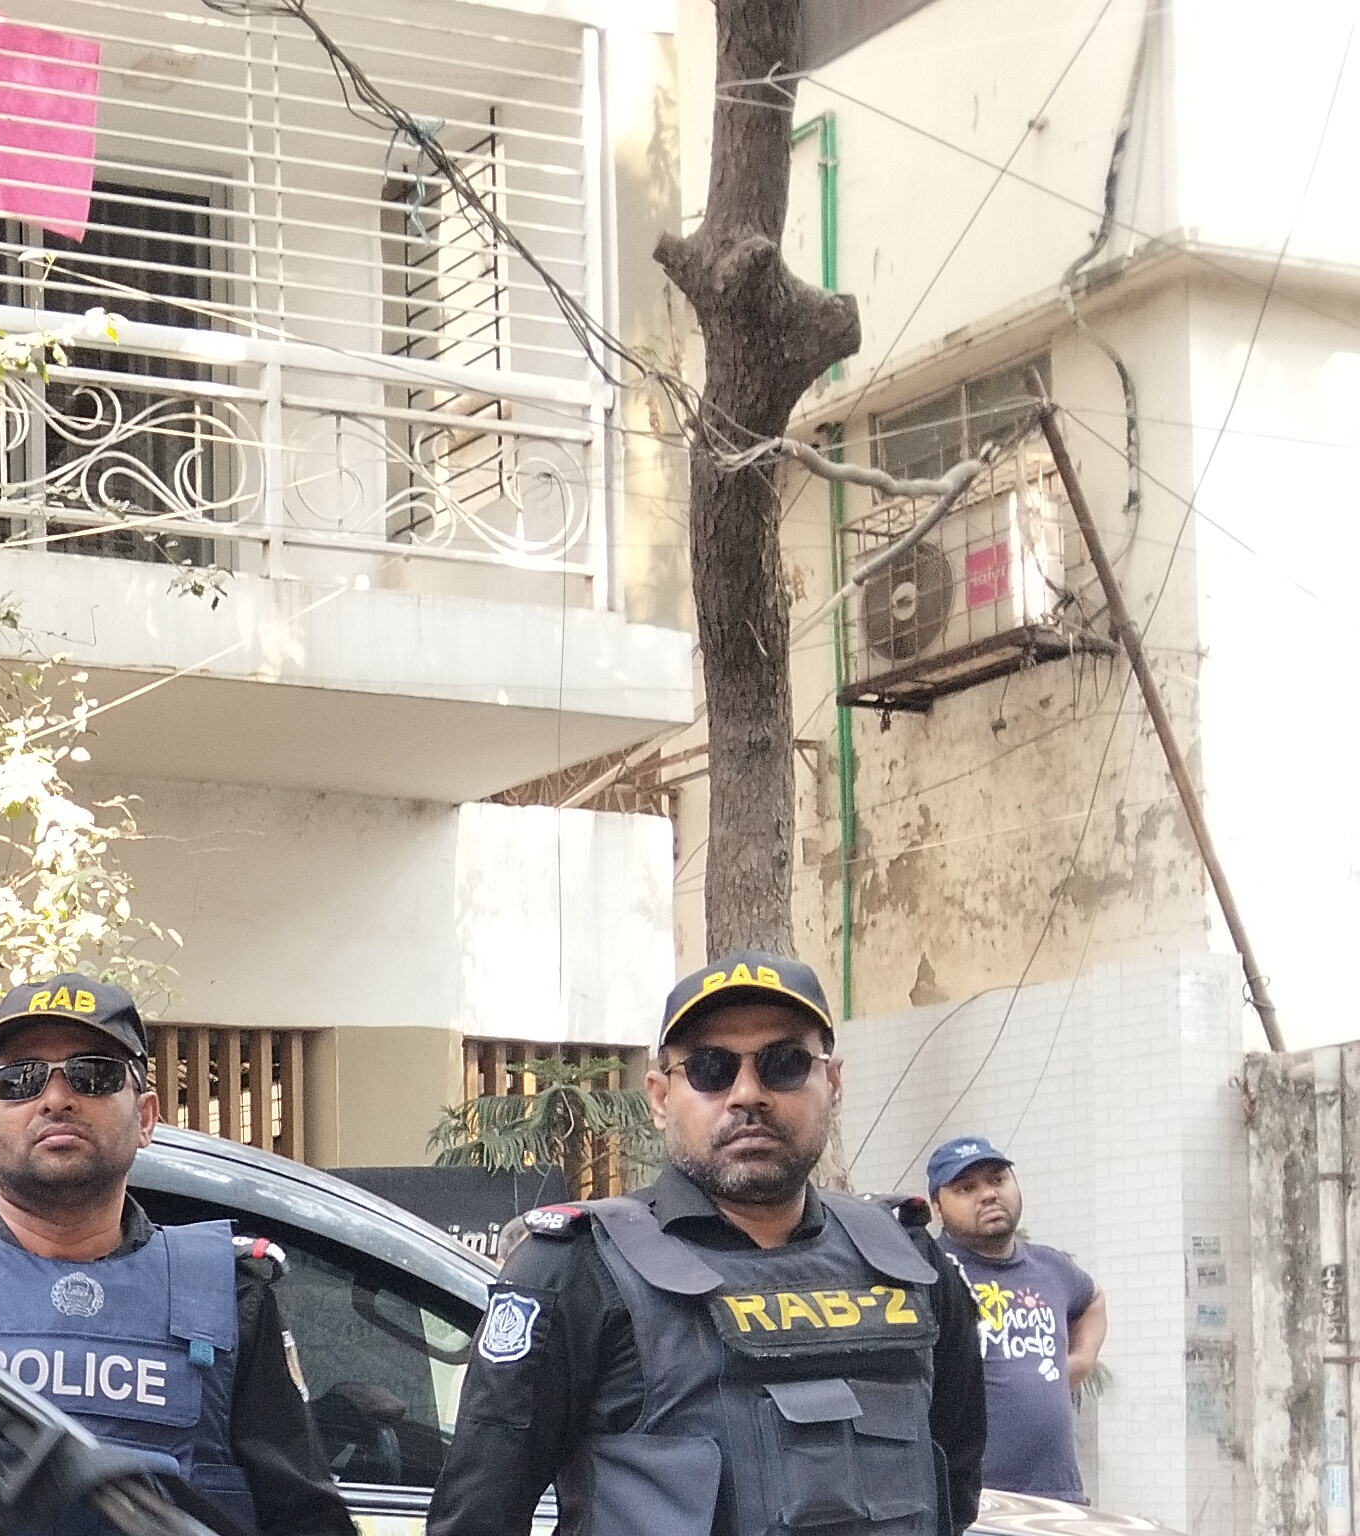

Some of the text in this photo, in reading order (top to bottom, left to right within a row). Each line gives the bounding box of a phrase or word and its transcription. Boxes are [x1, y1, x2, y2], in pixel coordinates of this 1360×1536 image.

[29, 986, 97, 1013] RAB
[525, 1210, 565, 1229] RAB
[722, 1285, 919, 1333] RAB-2
[978, 1302, 1056, 1335] Vacay
[977, 1319, 1056, 1359] Mode
